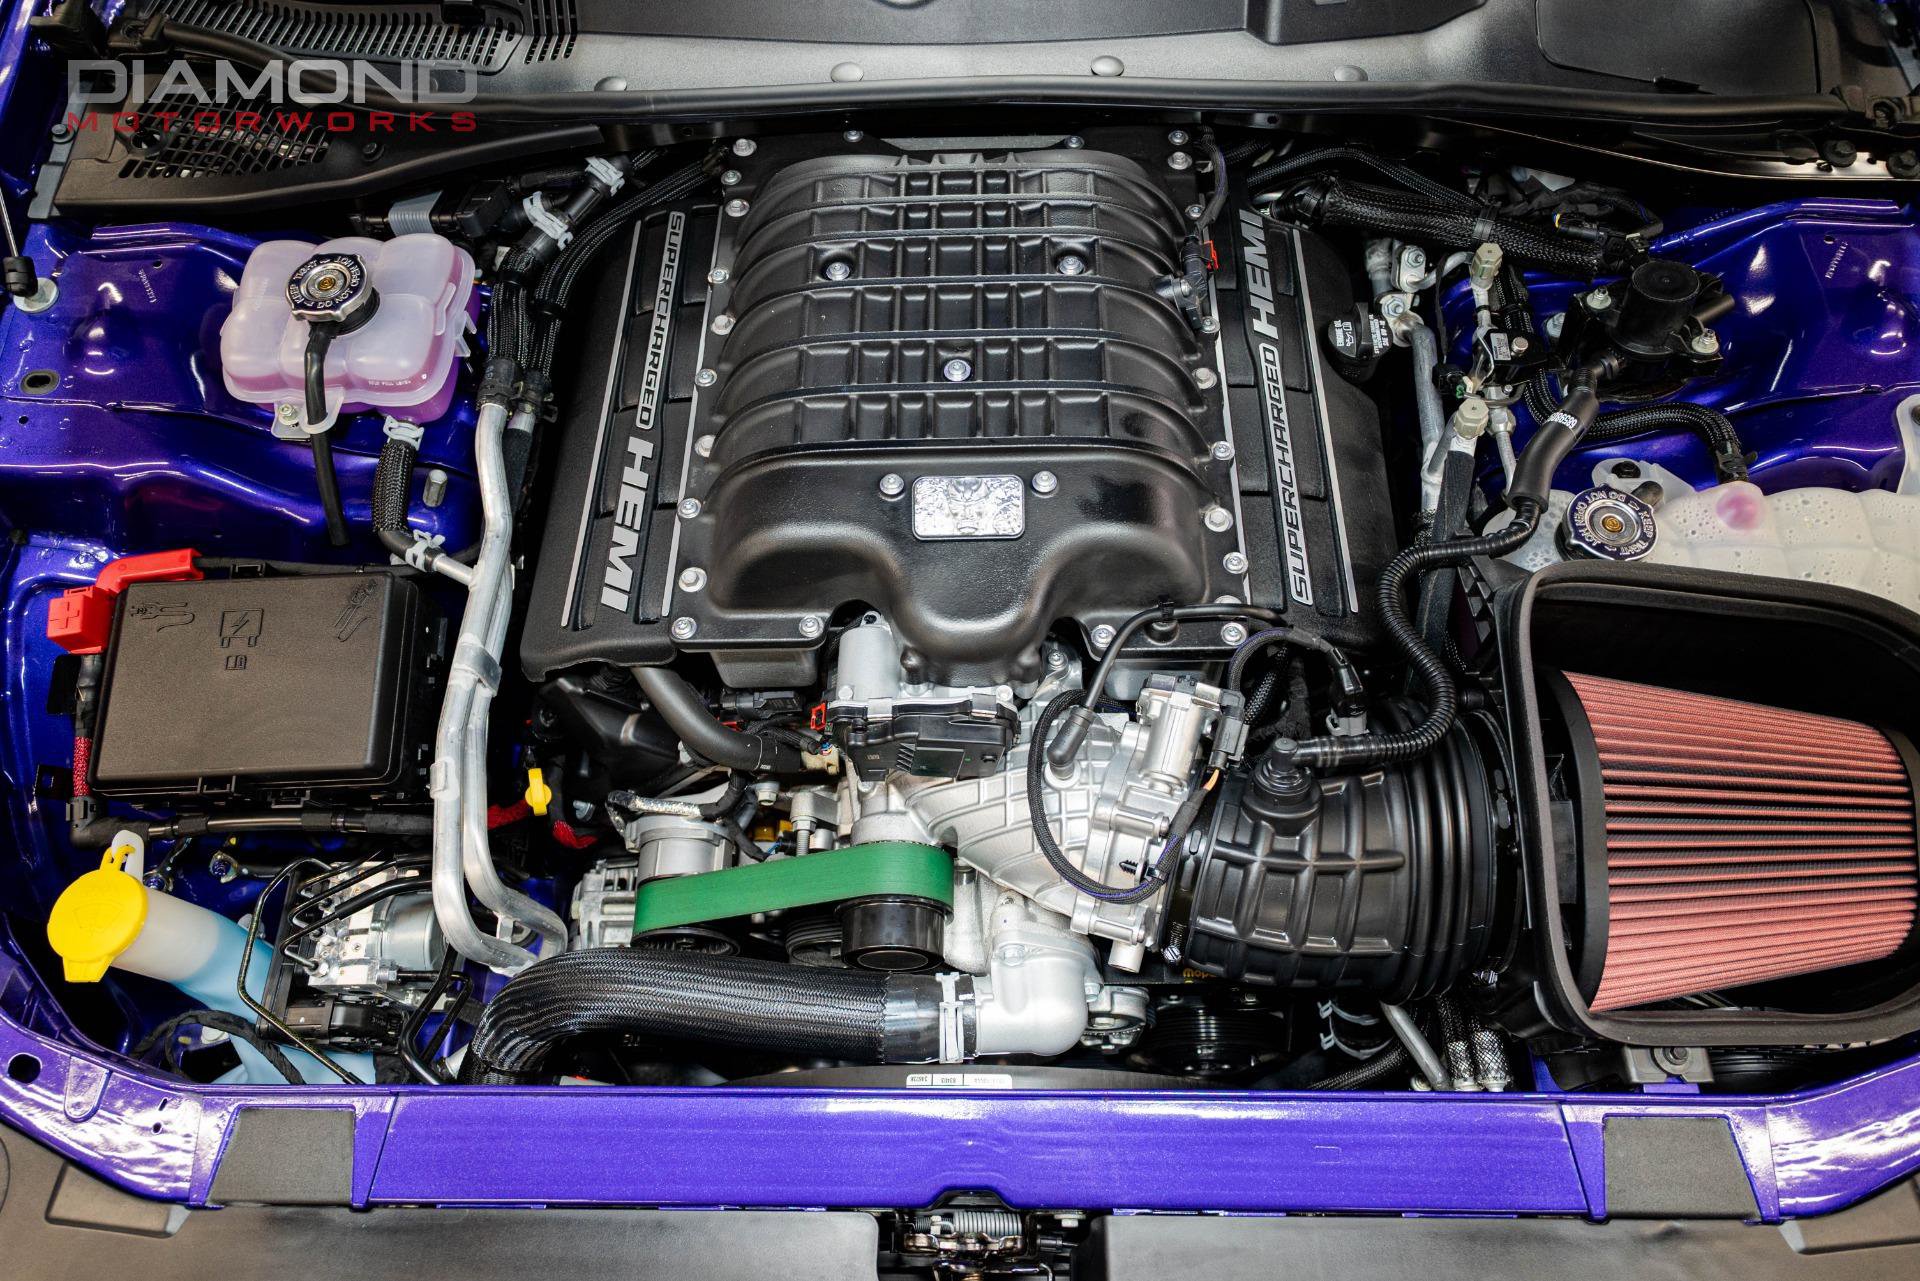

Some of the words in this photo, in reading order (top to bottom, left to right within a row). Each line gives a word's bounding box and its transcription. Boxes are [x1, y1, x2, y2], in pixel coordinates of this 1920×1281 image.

[1239, 209, 1279, 340] HEMI
[289, 284, 305, 303] KEEP
[316, 300, 333, 309] DO
[335, 288, 353, 303] NOT
[638, 212, 684, 429] SUPERCHARGED
[1335, 327, 1345, 347] ENGINE
[1262, 345, 1312, 603] SUPERCHARGED
[1585, 490, 1608, 503] NOT
[1608, 491, 1626, 502] DO
[601, 436, 654, 612] HEMI
[1639, 511, 1654, 538] KEEP
[1579, 527, 1601, 546] HOT
